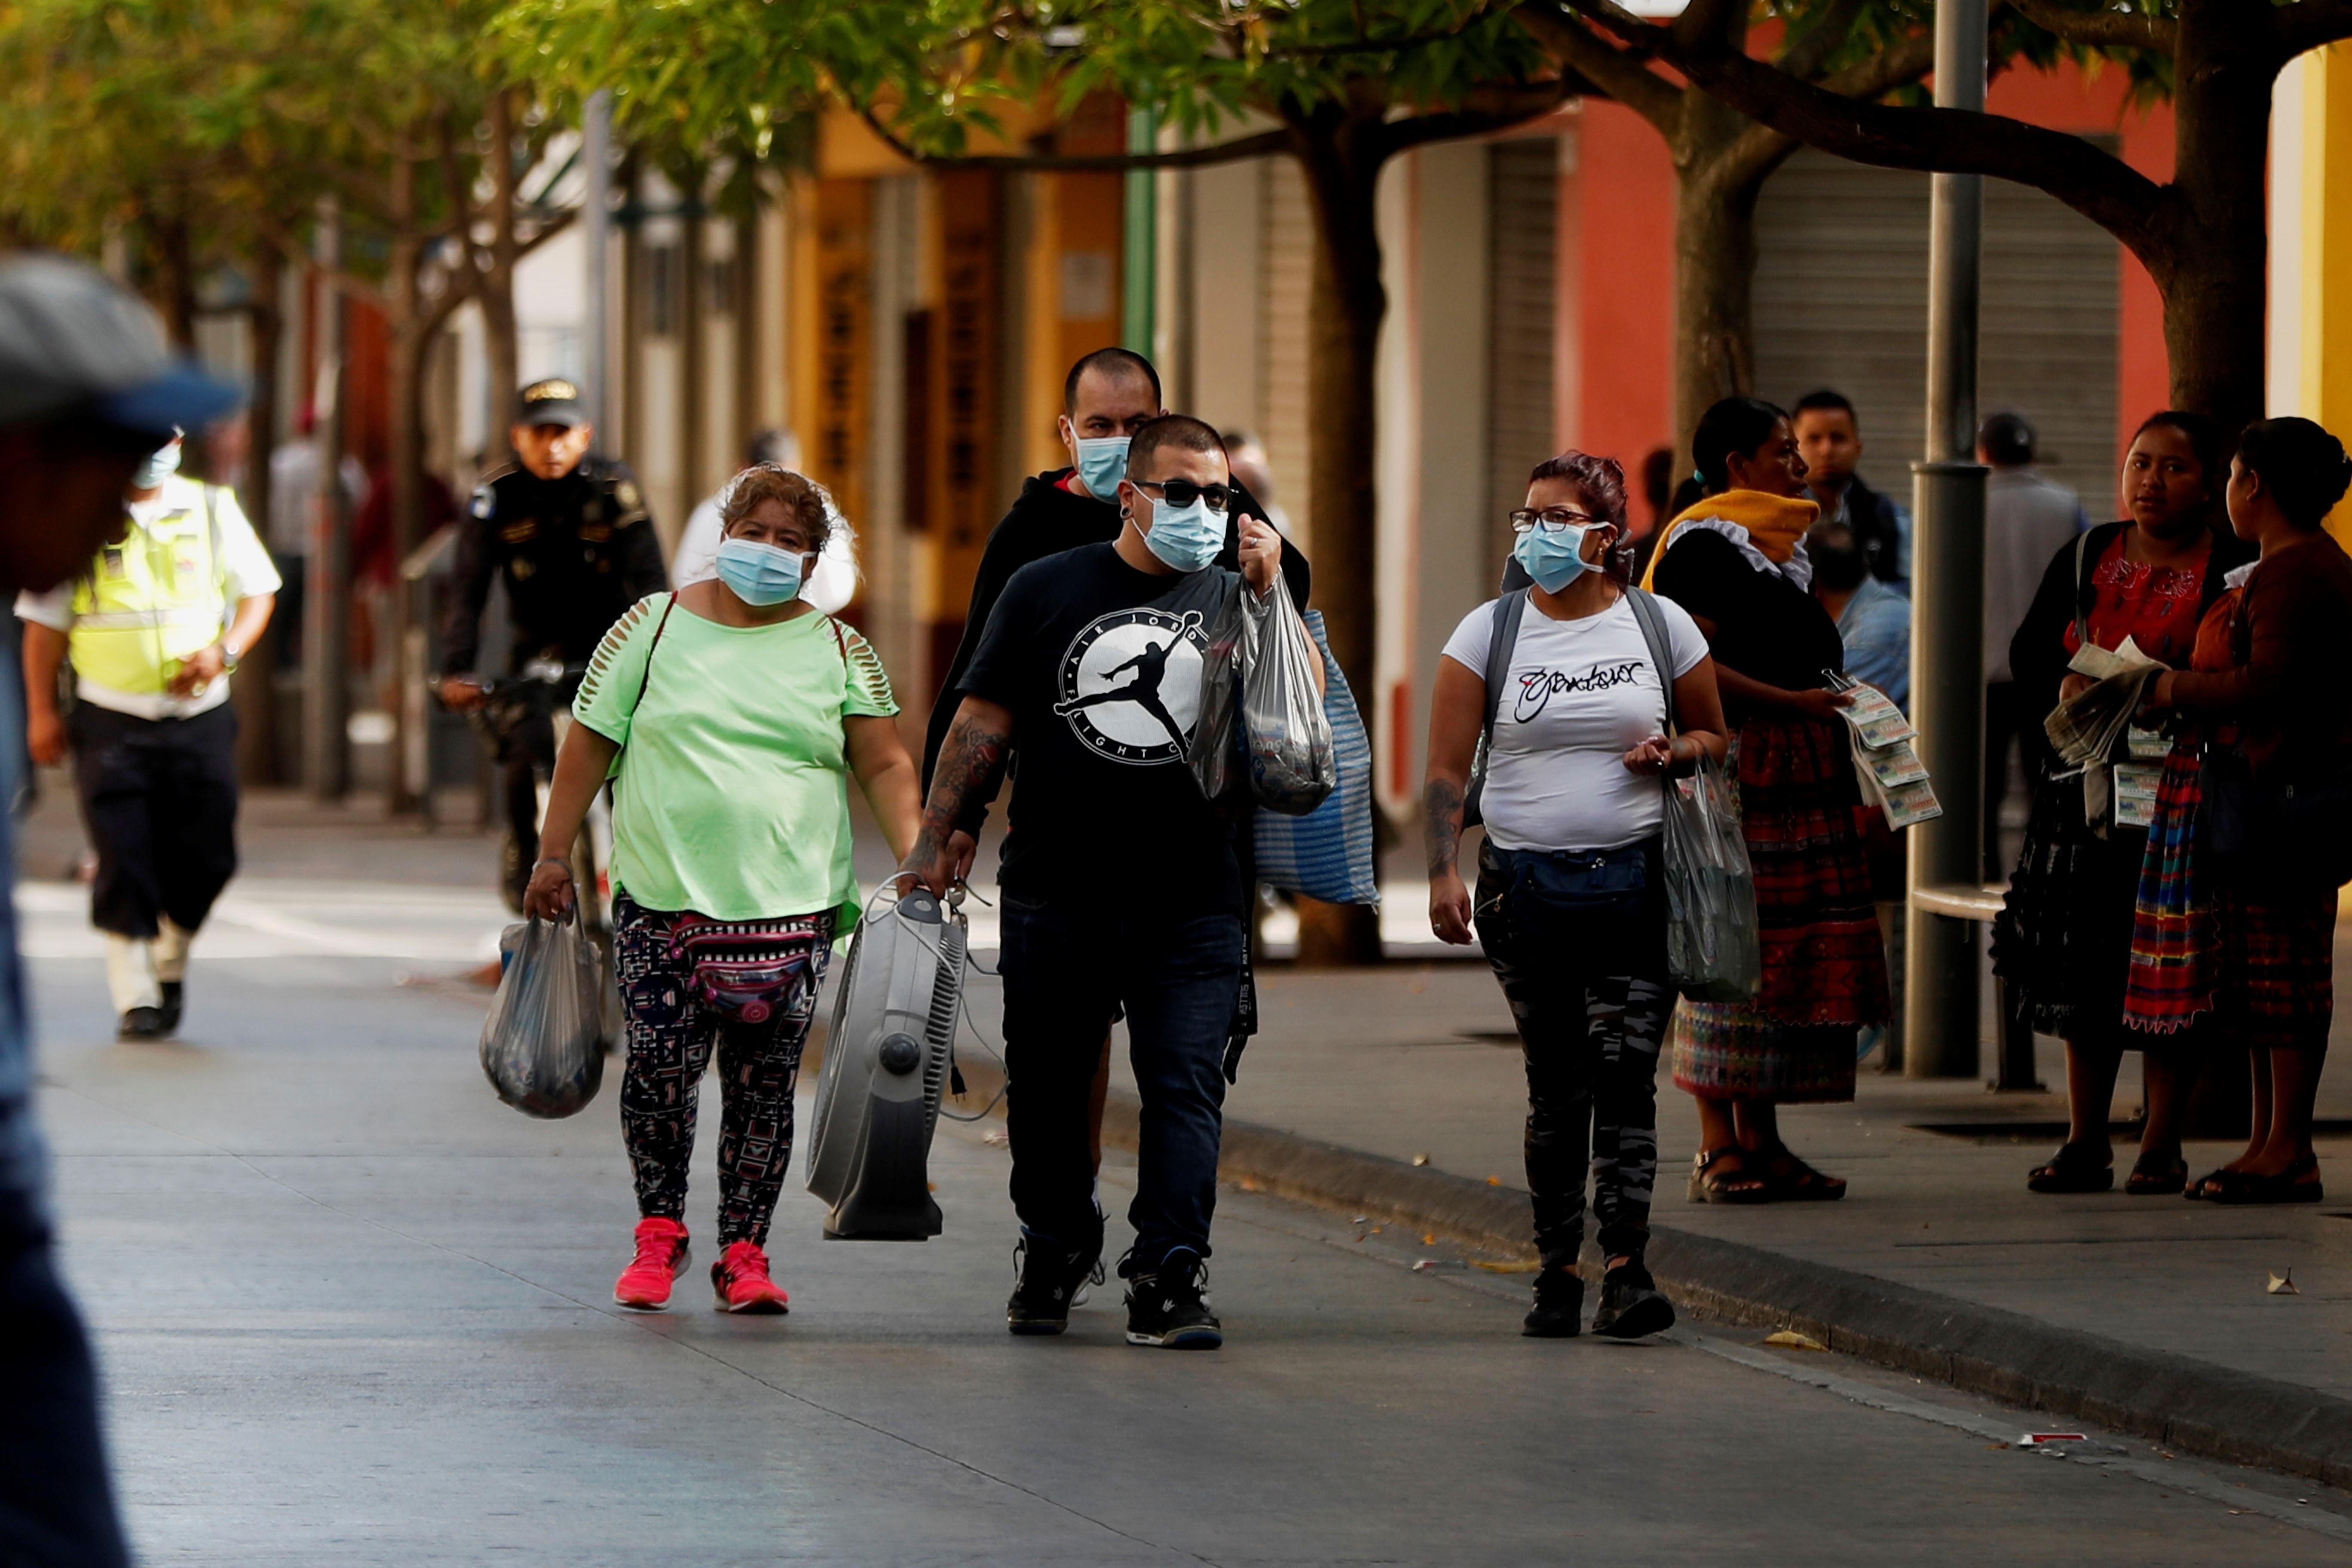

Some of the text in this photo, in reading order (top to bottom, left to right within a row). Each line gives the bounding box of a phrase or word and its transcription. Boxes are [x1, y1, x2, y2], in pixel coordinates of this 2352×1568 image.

[1070, 614, 1203, 665] AIR JORD
[1067, 689, 1147, 758] FLIGHT
